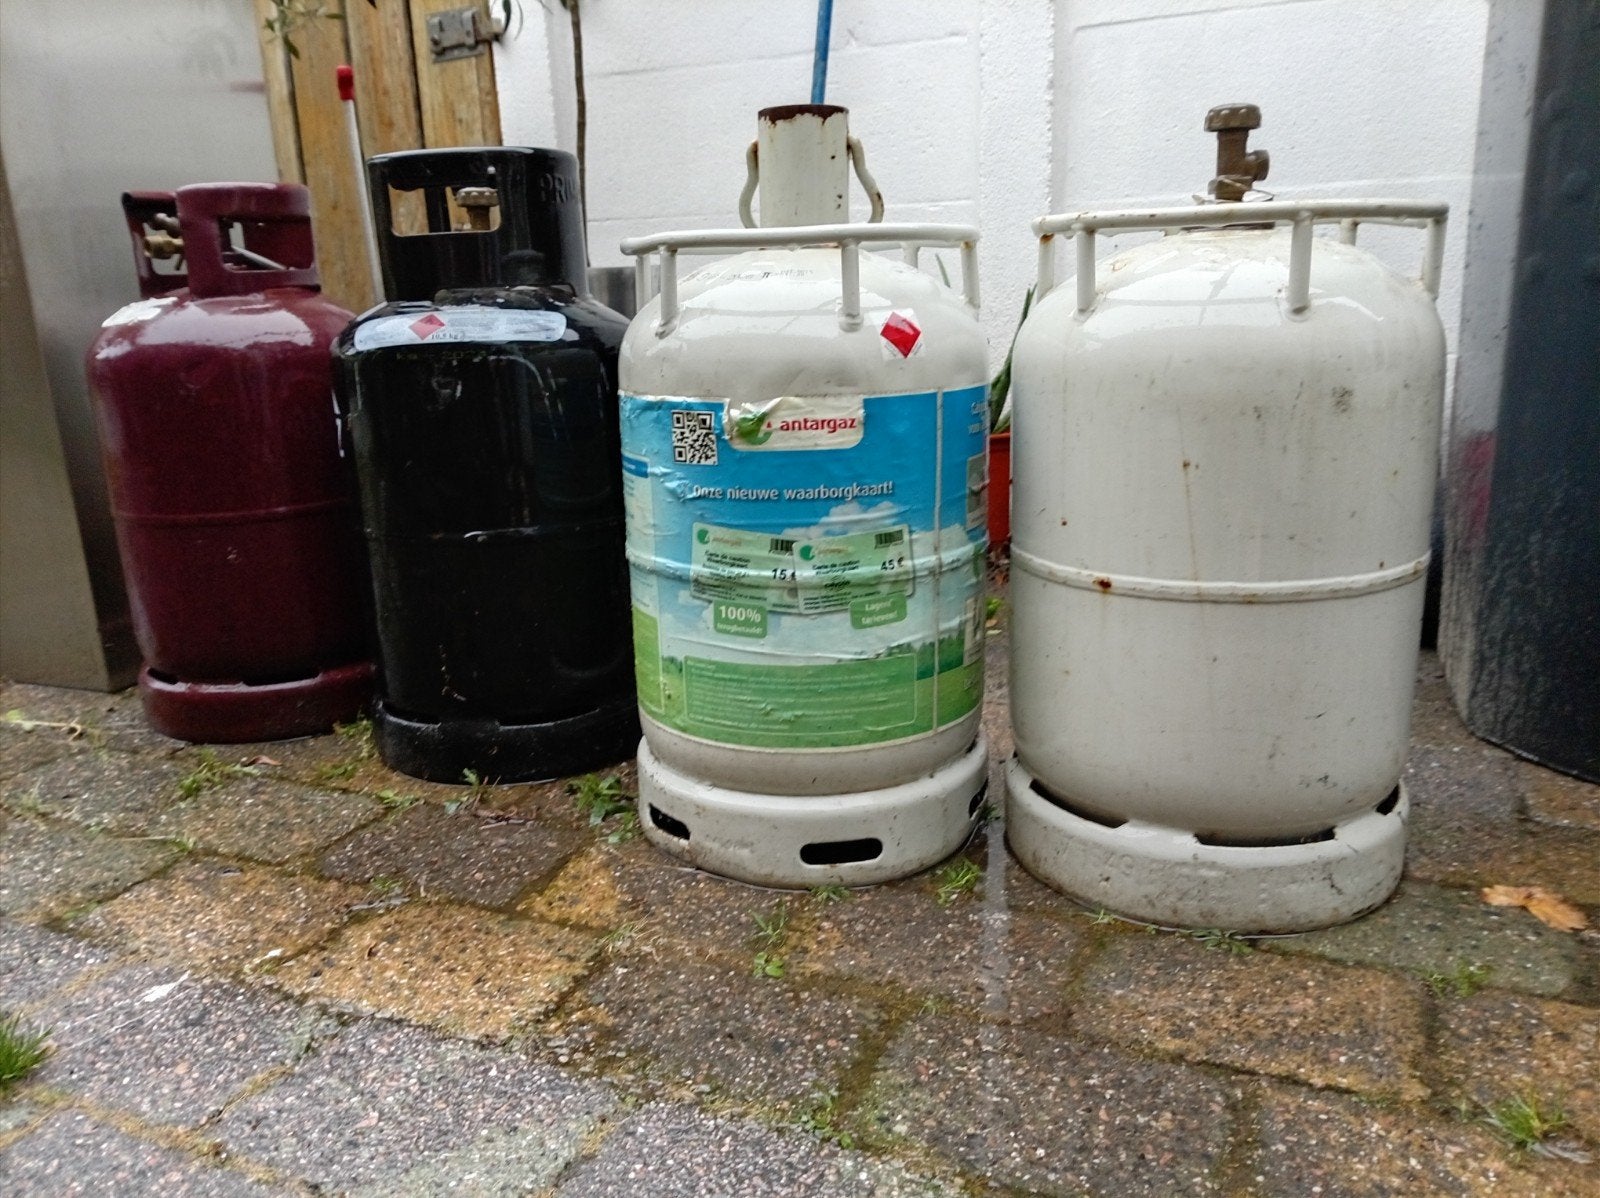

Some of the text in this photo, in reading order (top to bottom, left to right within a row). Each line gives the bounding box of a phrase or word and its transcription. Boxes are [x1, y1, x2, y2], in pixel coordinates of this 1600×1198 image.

[780, 417, 857, 434] antargaz
[694, 481, 893, 501] Onze nieuwe waarborgkaart!
[880, 557, 895, 571] 45
[772, 568, 787, 580] 15
[719, 605, 761, 624] 100%
